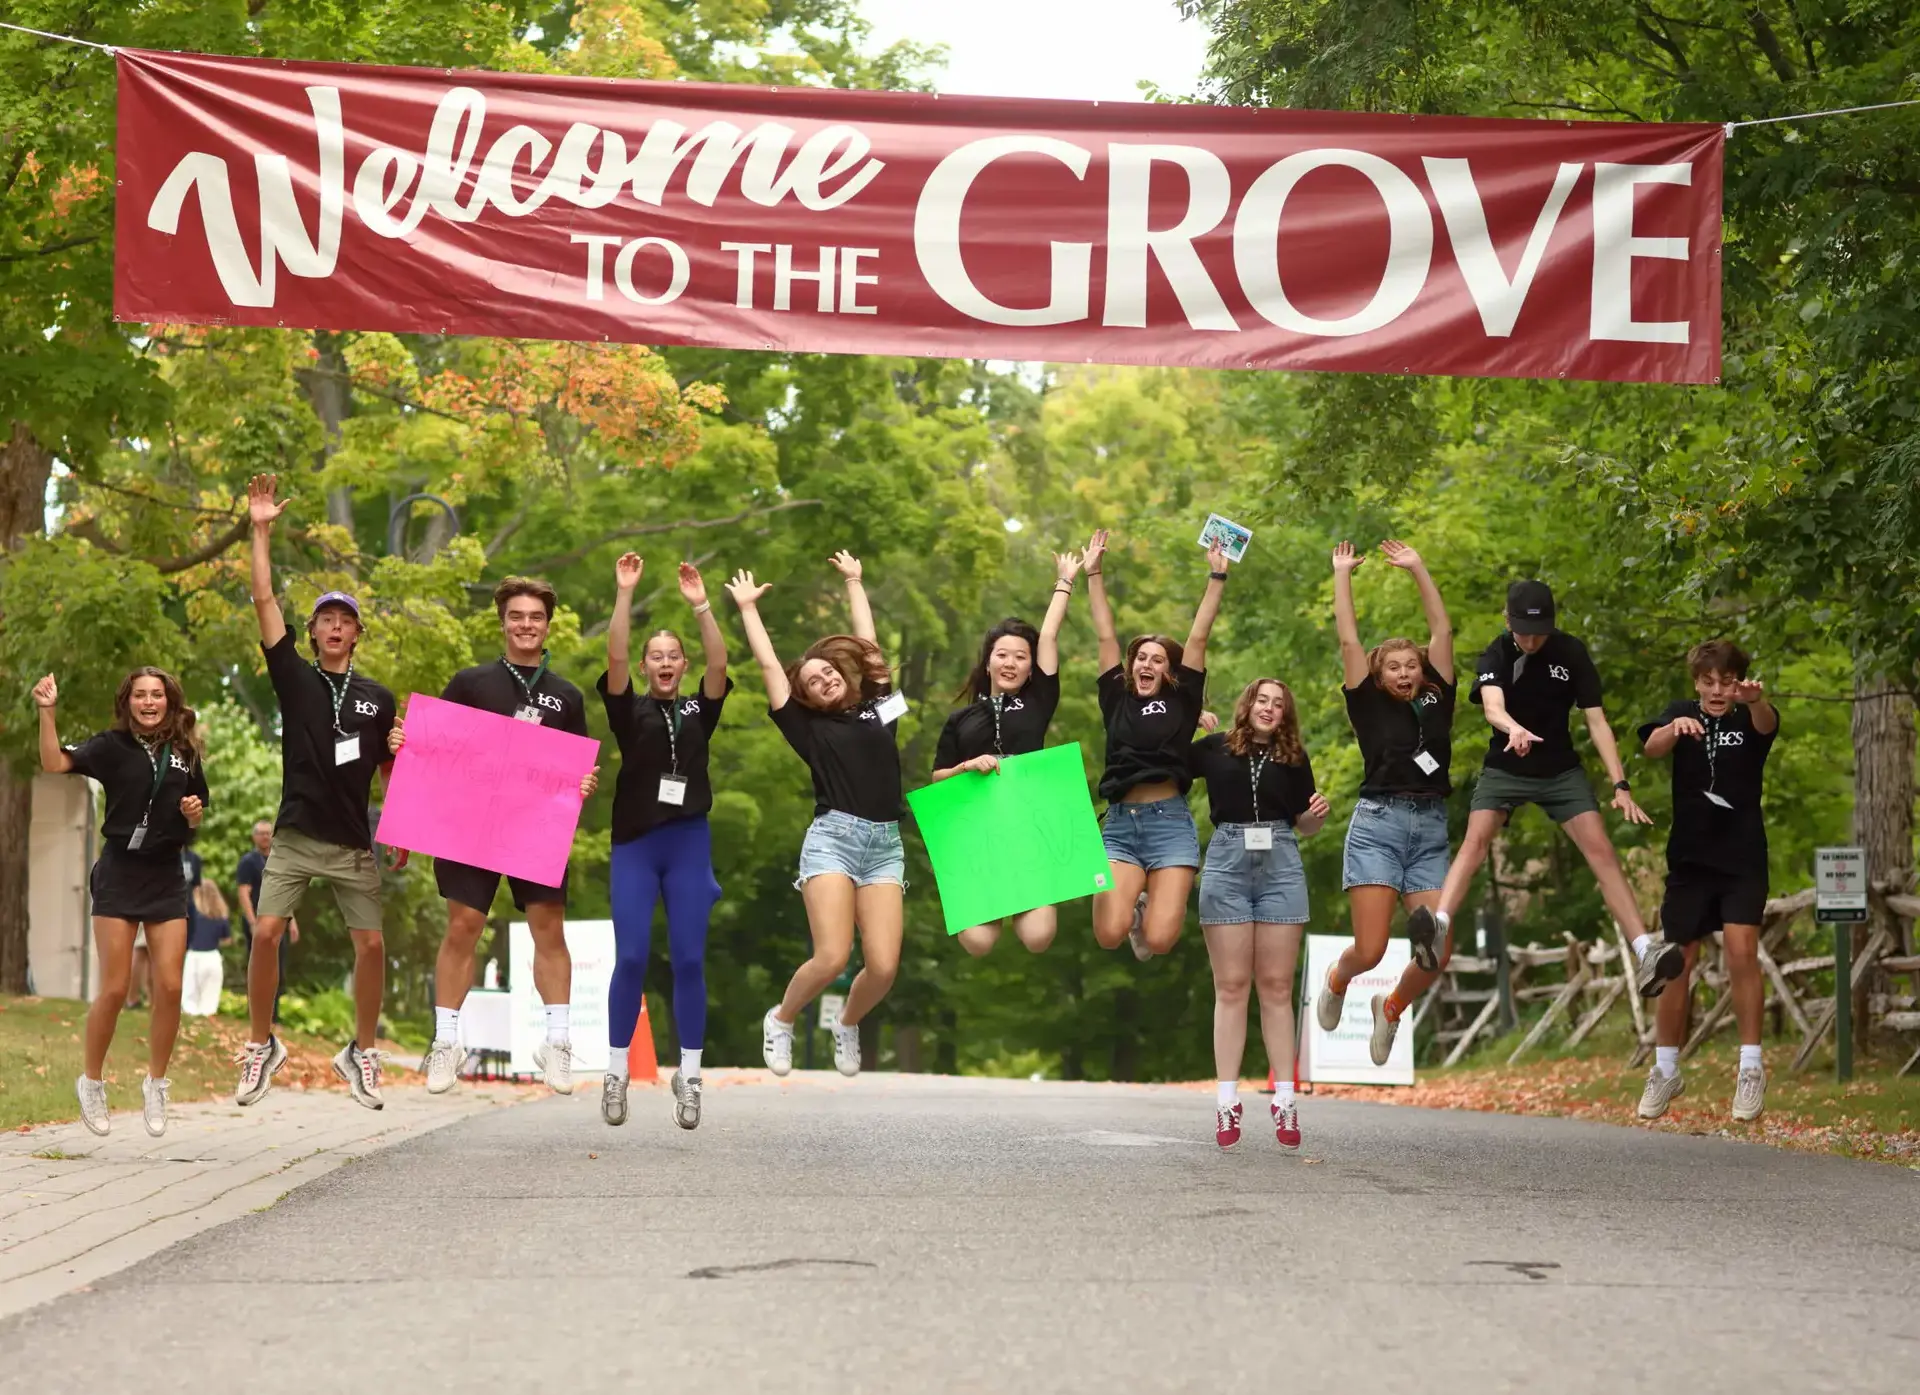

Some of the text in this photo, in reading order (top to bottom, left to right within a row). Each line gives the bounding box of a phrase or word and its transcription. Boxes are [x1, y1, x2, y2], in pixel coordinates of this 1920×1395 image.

[148, 86, 885, 307] Welcome
[570, 233, 880, 315] TO THE
[914, 135, 1693, 343] GROVE
